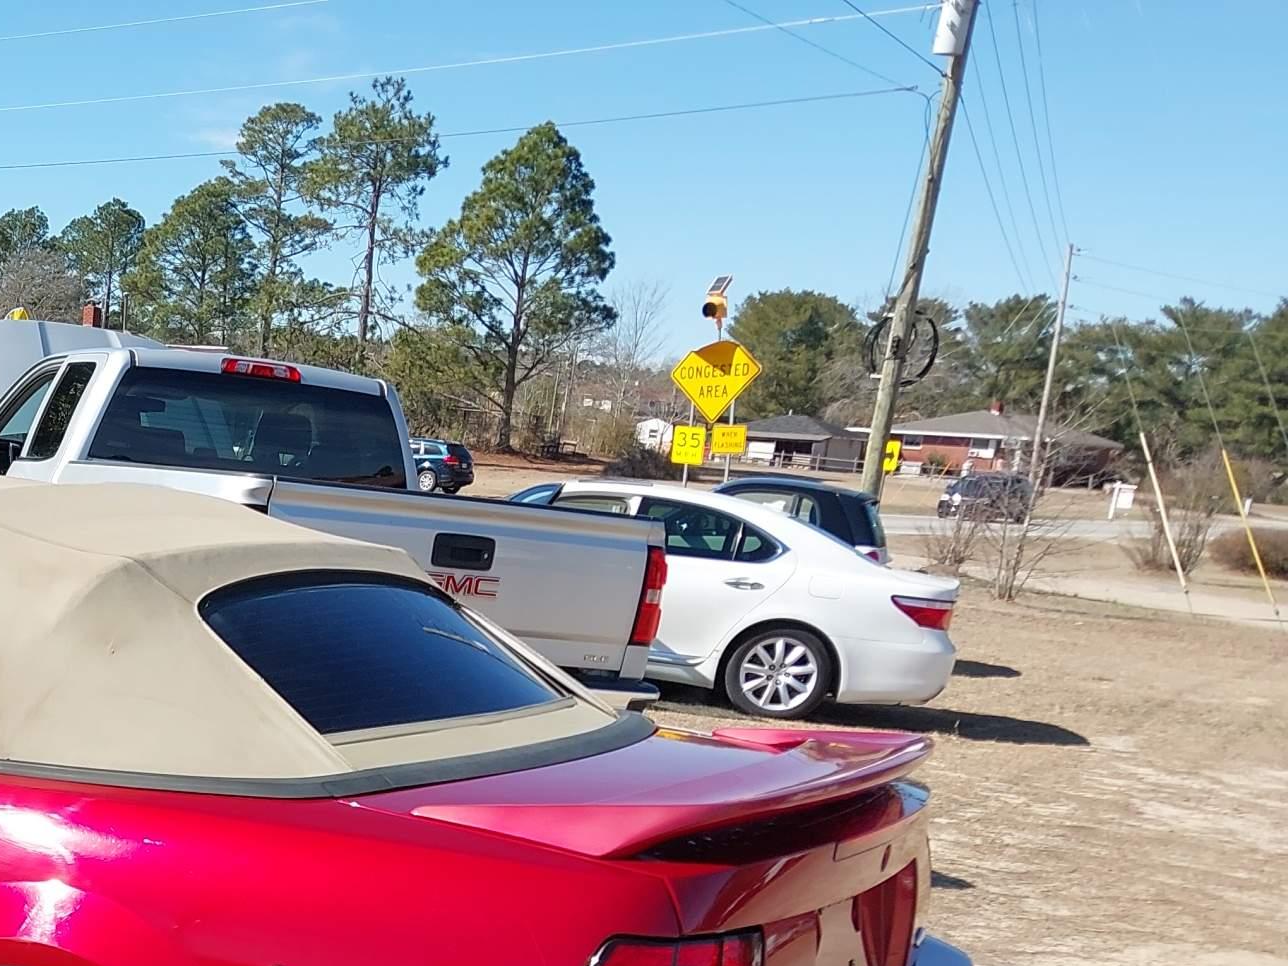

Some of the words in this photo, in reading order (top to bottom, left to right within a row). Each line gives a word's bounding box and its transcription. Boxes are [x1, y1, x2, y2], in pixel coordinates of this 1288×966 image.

[680, 363, 750, 380] CONGESTED
[698, 385, 728, 399] AREA
[677, 432, 701, 448] 35
[714, 441, 743, 449] FLASHING
